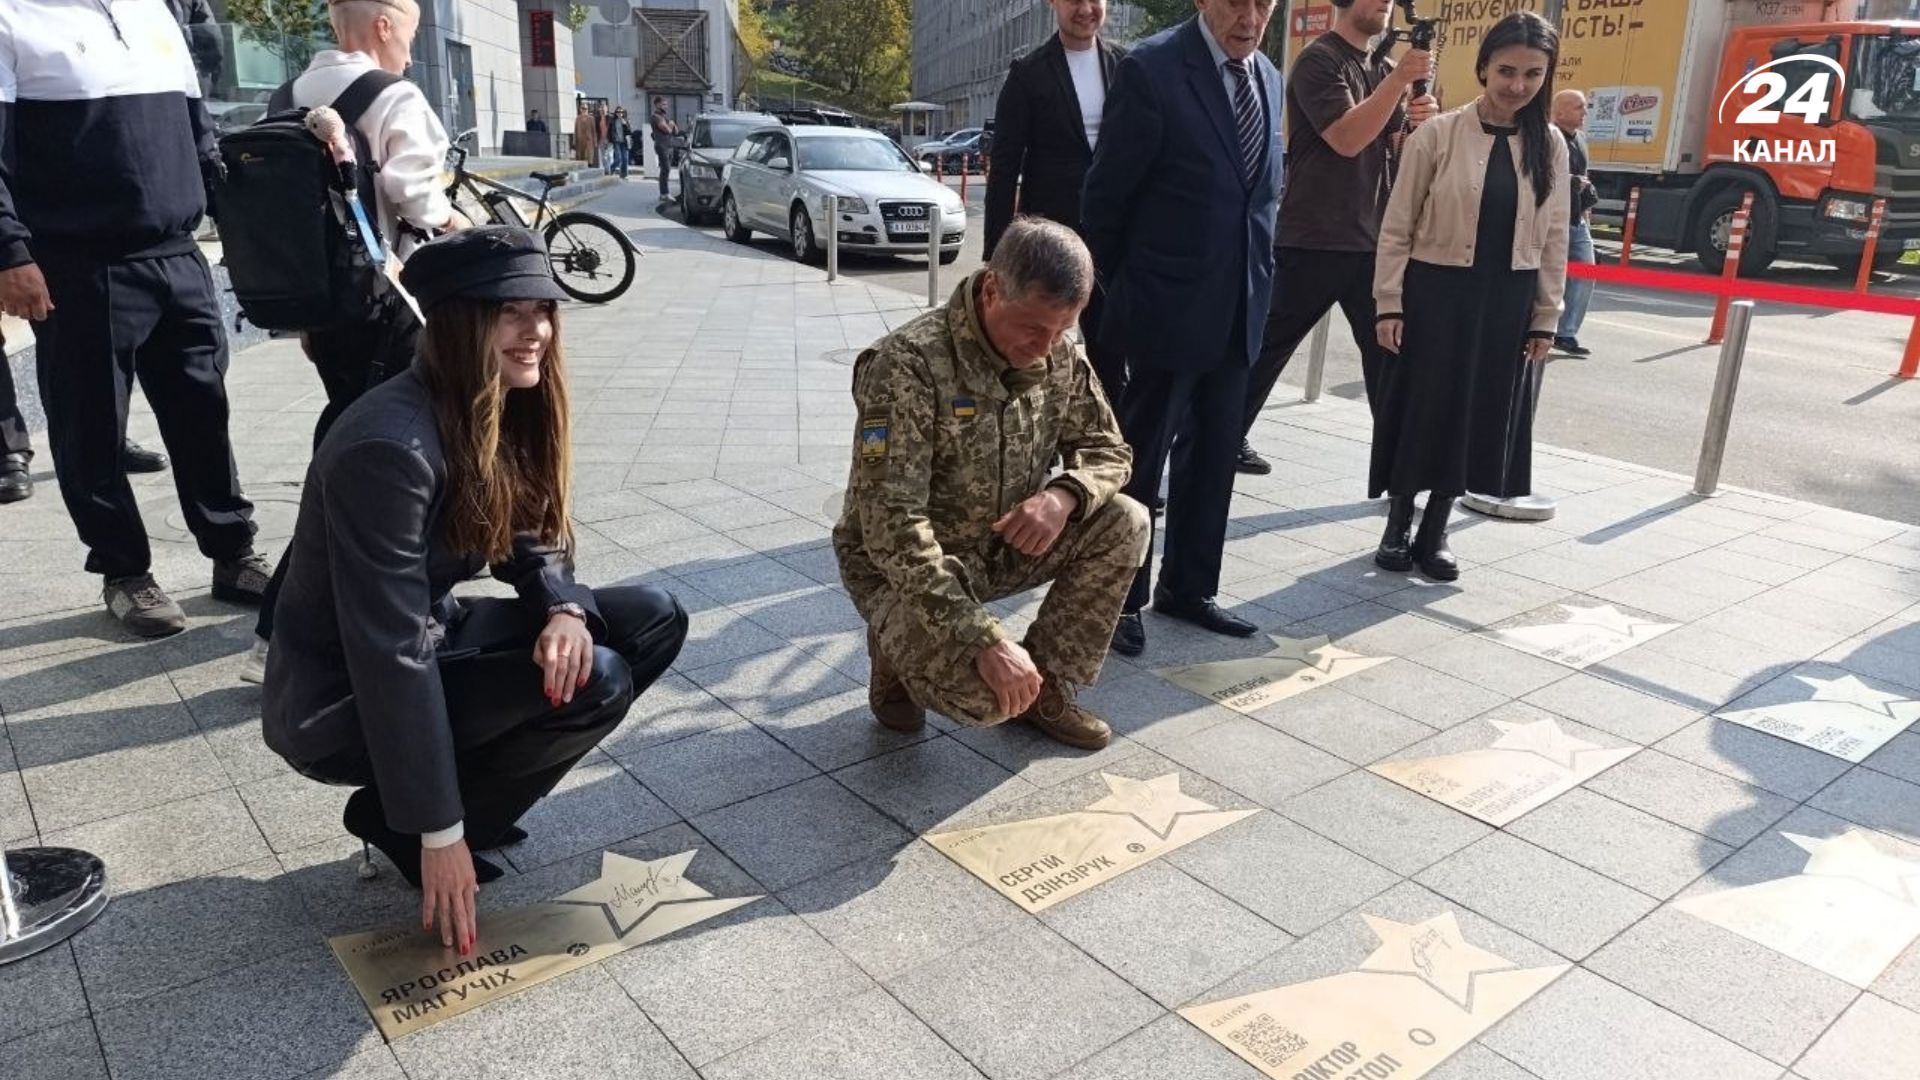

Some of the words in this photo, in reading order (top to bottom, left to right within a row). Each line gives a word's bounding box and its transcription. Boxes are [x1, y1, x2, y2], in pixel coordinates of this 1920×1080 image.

[999, 854, 1065, 888] СЕРГІЙ
[1021, 855, 1116, 903] ДЗІНЗІРУК
[381, 943, 528, 1004] ЯРОСЛАВА
[392, 968, 516, 1024] МАГУЧІХ
